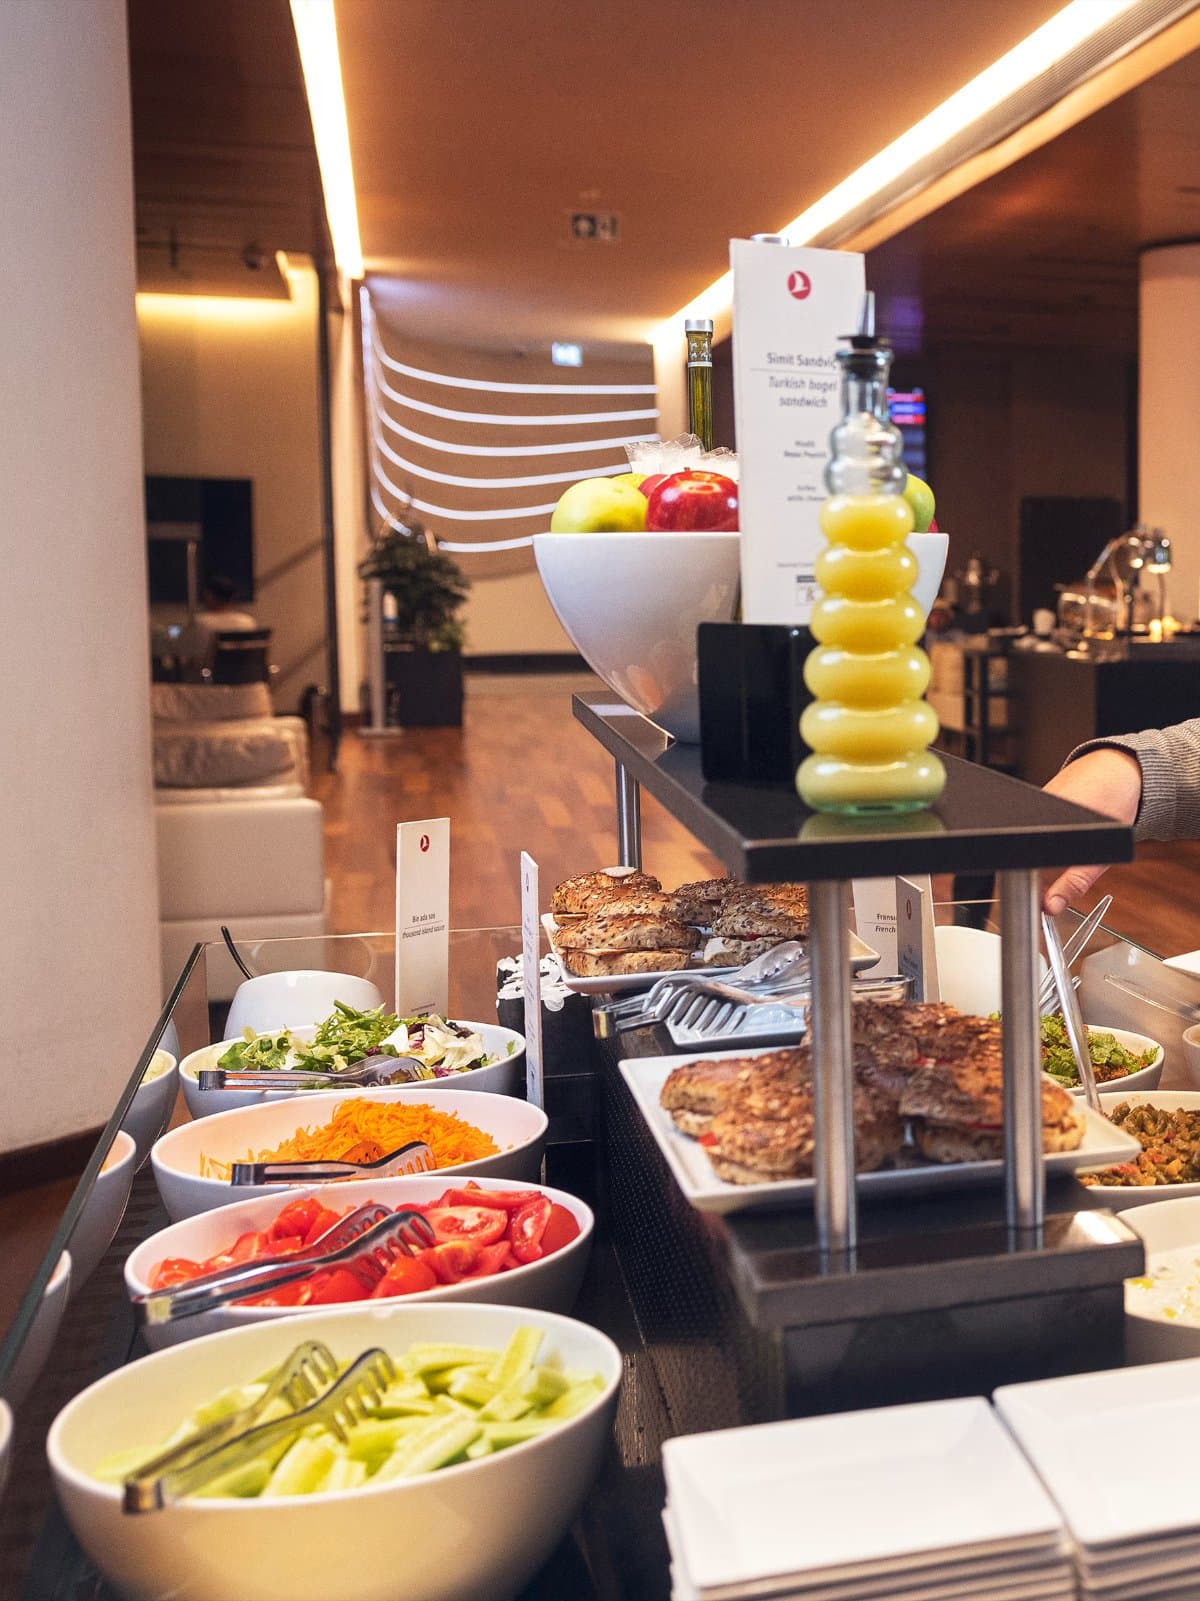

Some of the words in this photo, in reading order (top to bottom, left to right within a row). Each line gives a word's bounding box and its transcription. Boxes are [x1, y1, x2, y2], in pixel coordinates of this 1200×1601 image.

[767, 352, 794, 365] Simit
[769, 376, 806, 389] Turkish
[779, 396, 828, 408] sandwich
[876, 913, 896, 921] Fransı
[875, 925, 896, 933] French
